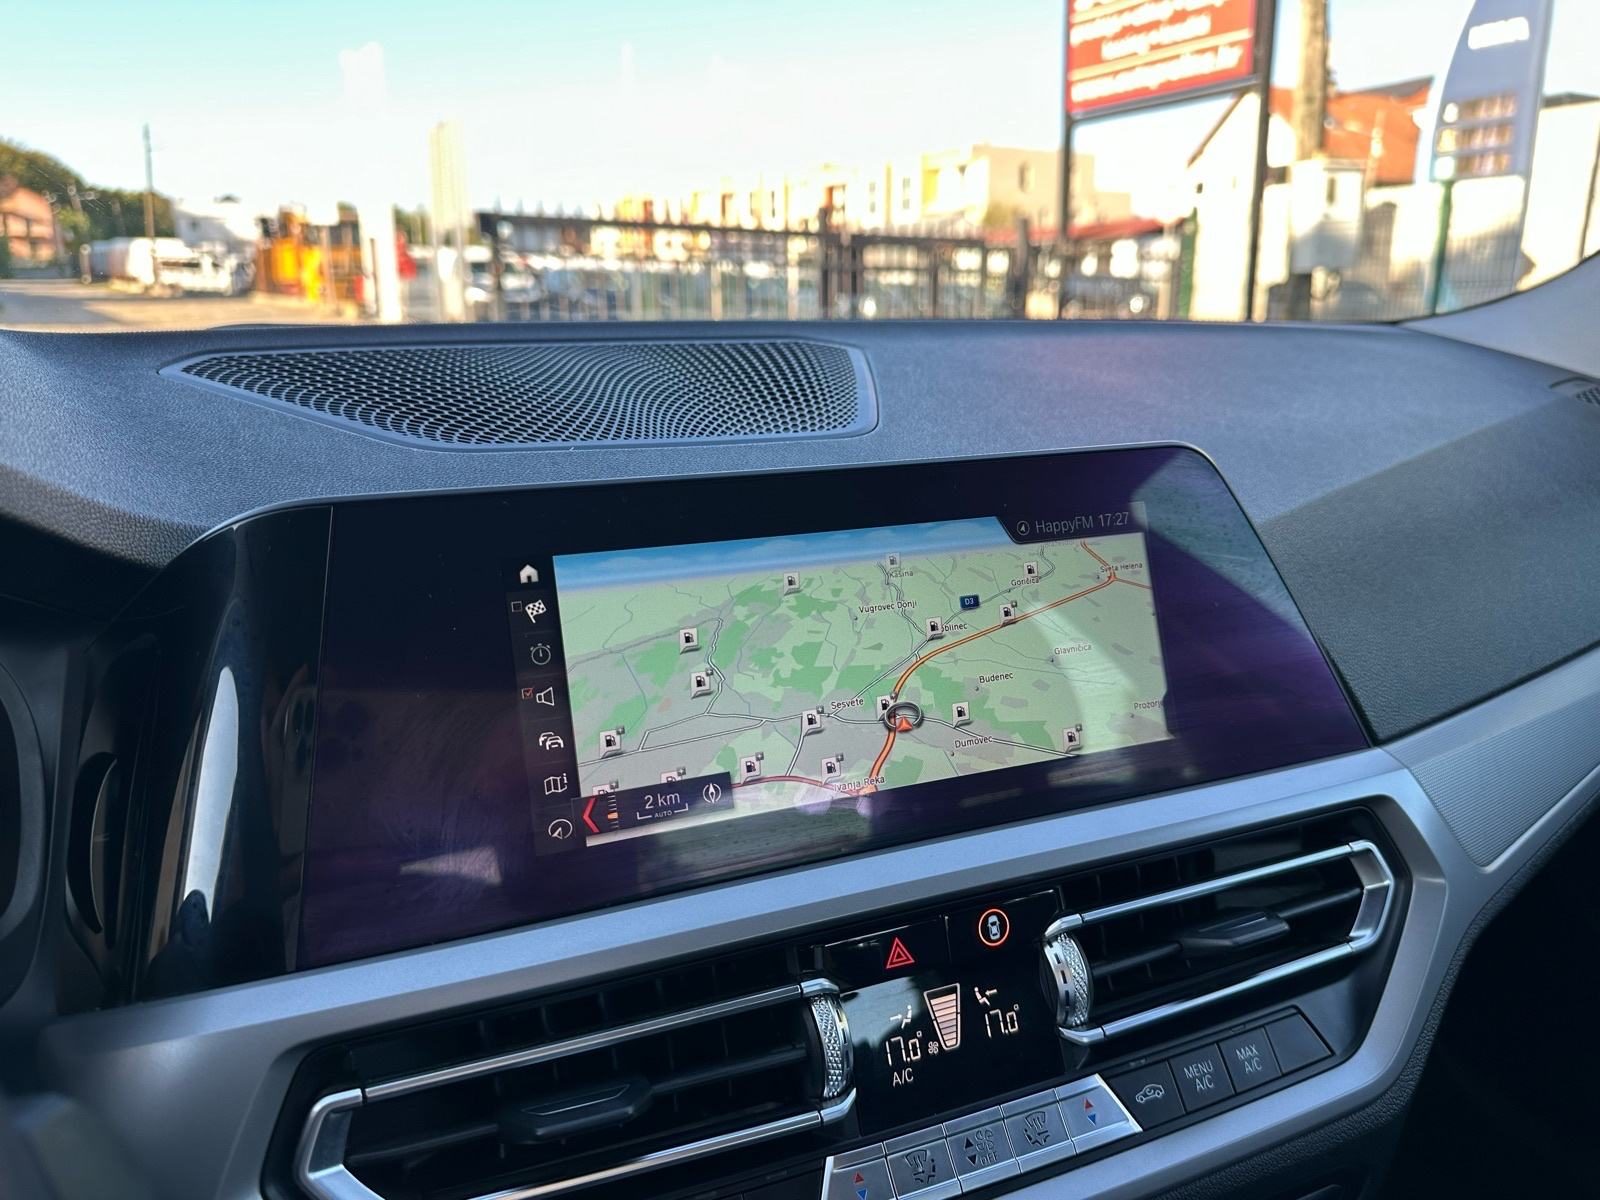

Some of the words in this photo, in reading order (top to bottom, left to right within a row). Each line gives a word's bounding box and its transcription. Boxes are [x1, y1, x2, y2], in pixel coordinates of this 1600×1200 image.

[1035, 515, 1094, 535] HappyFM
[1098, 511, 1129, 528] 17:27
[858, 603, 895, 614] Vugrovec
[896, 600, 917, 610] Donji
[964, 597, 974, 606] D3
[979, 672, 1014, 684] Budenec
[831, 697, 864, 710] Sesvete
[954, 735, 993, 749] Dumovec
[863, 775, 885, 788] Reka
[644, 794, 654, 809] 2
[657, 792, 681, 807] km
[1235, 1043, 1259, 1060] MAX
[1183, 1059, 1214, 1079] MENU
[1244, 1057, 1262, 1074] A/C
[892, 1067, 914, 1088] A/C
[1195, 1074, 1214, 1092] A/C
